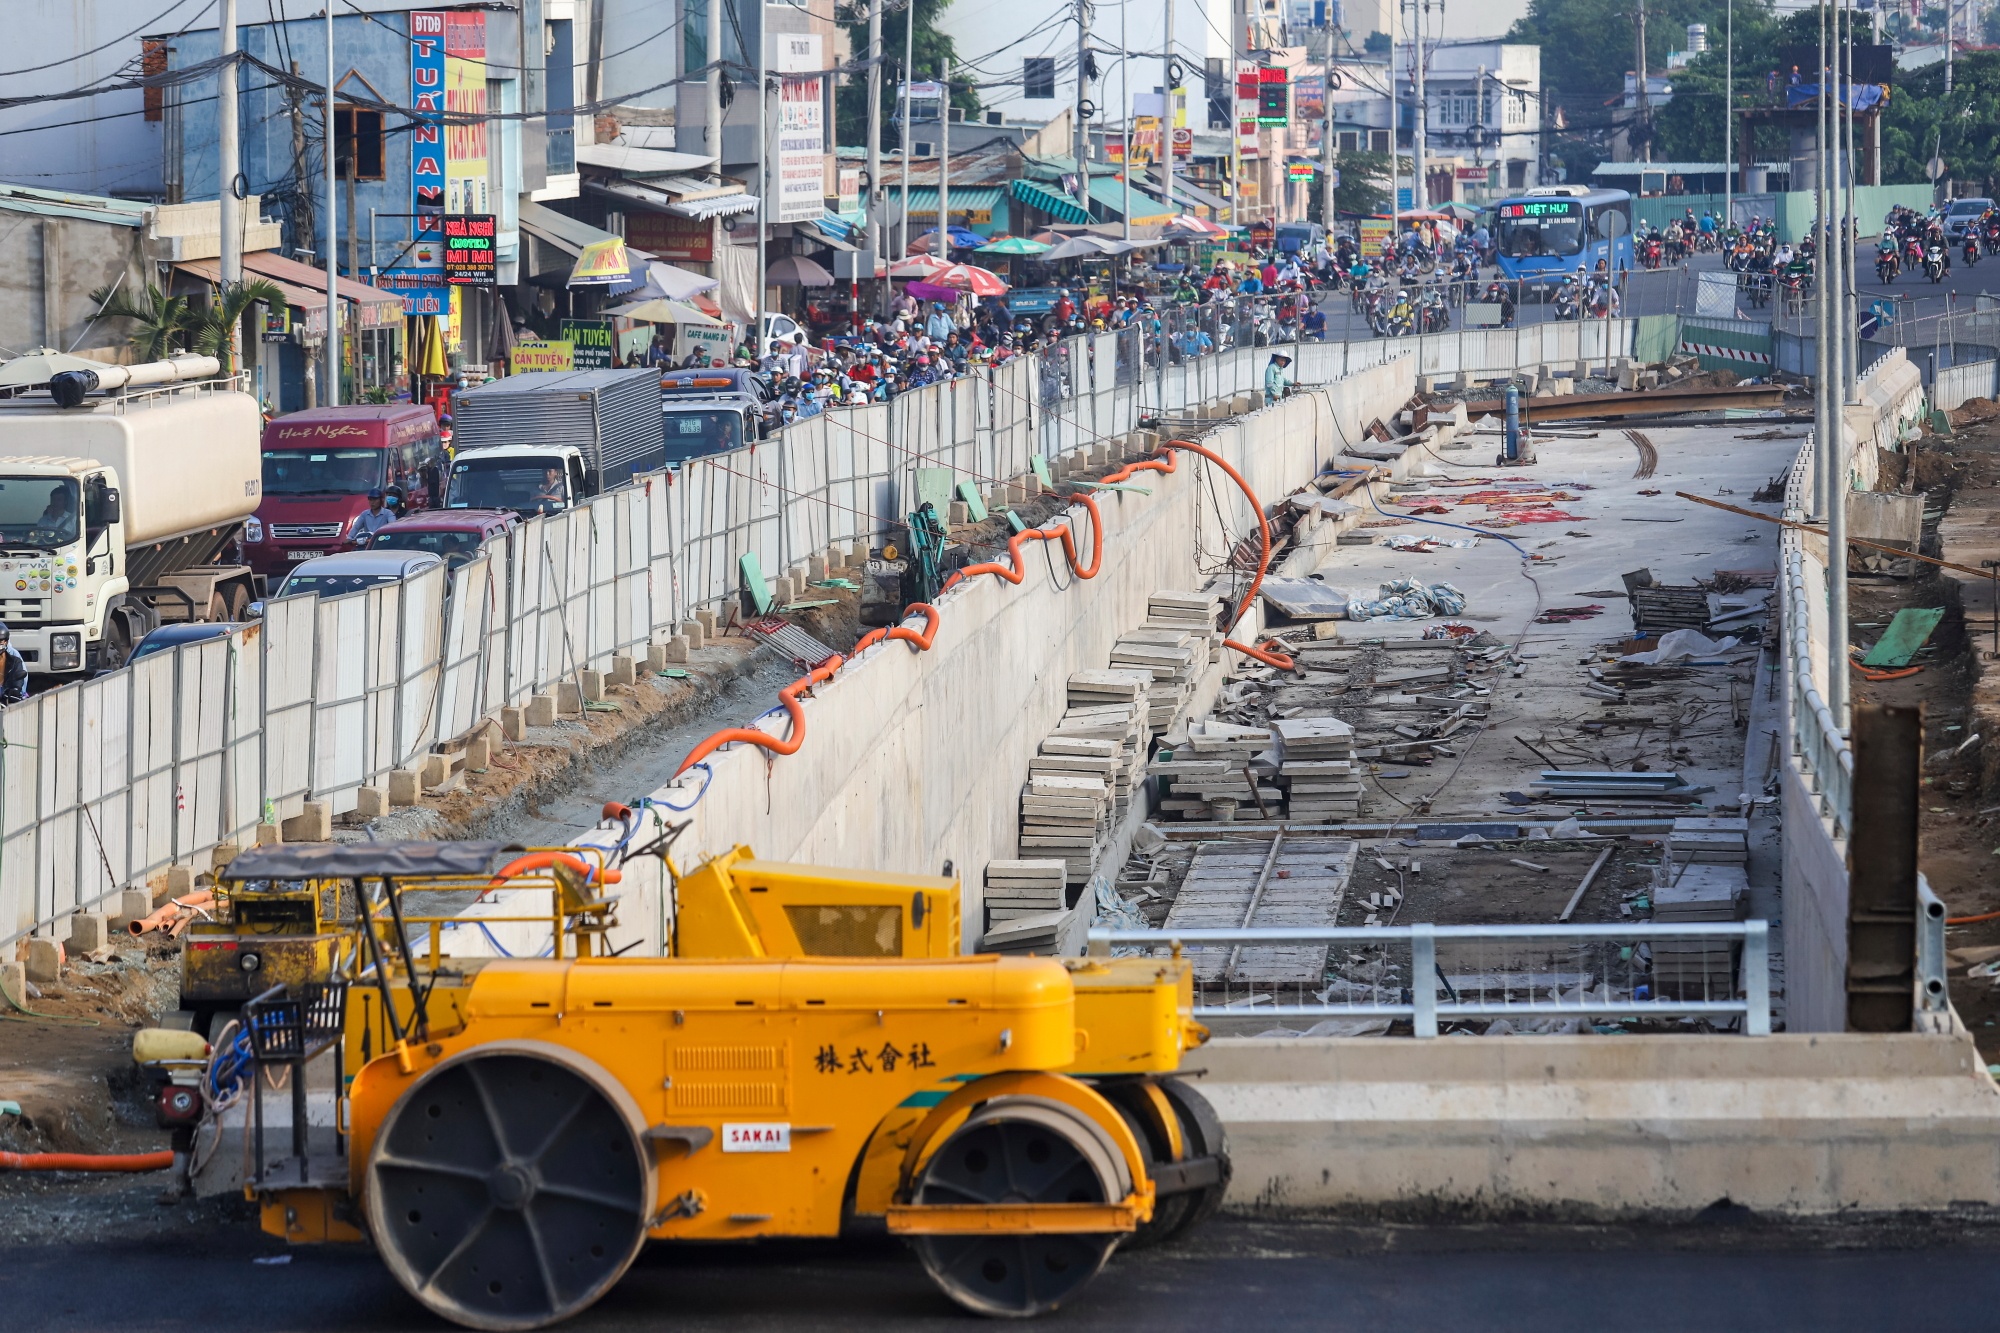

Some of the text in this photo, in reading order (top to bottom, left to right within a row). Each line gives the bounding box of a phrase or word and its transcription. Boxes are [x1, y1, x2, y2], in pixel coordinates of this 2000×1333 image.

[1524, 203, 1547, 216] VIỆT
[446, 217, 494, 236] NHÀ NGHỈ
[450, 237, 489, 249] (MOTEL)
[447, 250, 493, 263] MI MI
[396, 271, 421, 289] HÌNH
[402, 292, 440, 313] ẤY LIỀN
[583, 322, 612, 347] TUYỂN
[702, 332, 720, 341] MANG
[514, 349, 563, 365] CẦN TUYỂN
[814, 1041, 937, 1075] 株式會社
[732, 1130, 780, 1142] SAKAI
